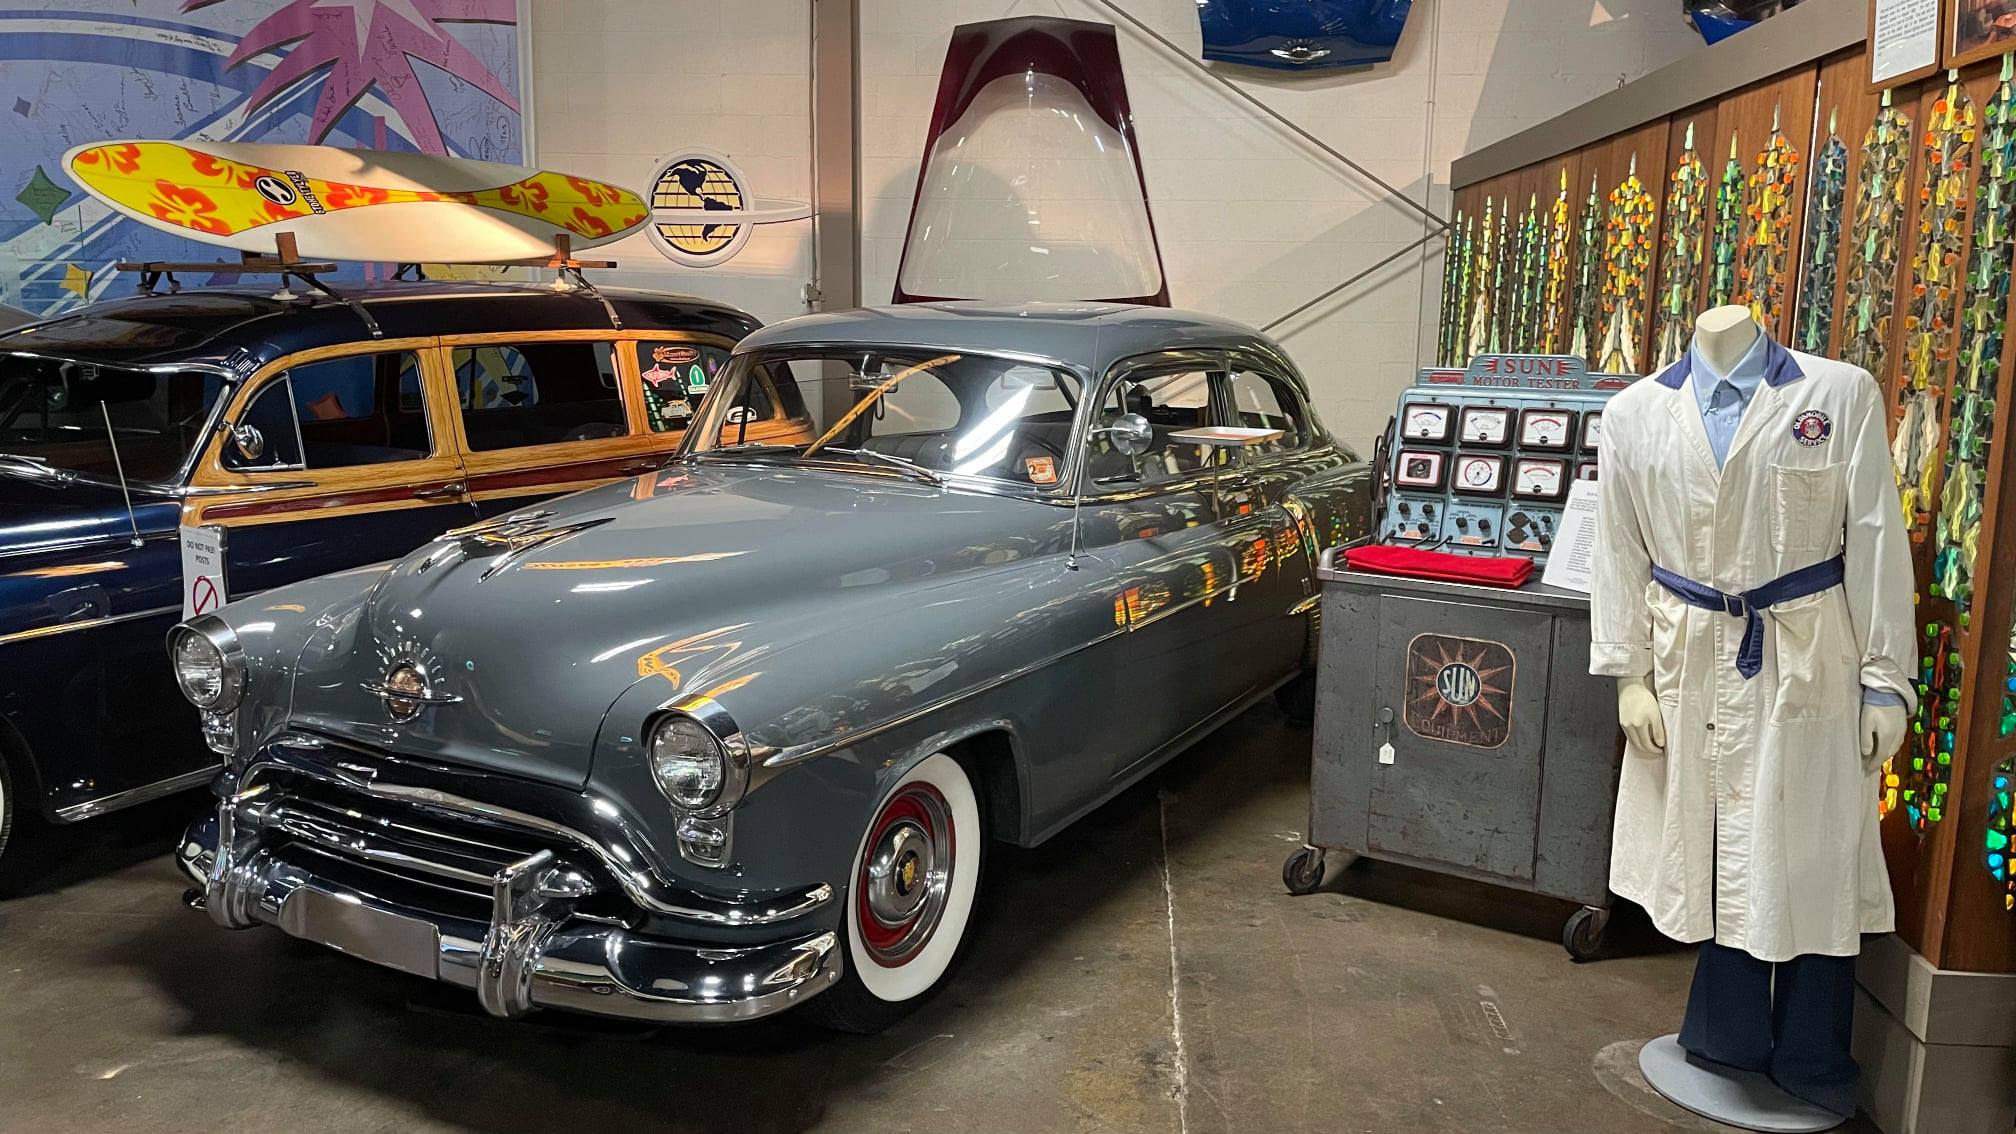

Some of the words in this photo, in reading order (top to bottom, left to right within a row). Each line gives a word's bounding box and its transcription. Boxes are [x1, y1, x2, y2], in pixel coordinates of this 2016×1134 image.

[1503, 358, 1554, 375] SUN
[694, 370, 700, 383] 1
[1473, 376, 1520, 388] MOTOR
[1527, 378, 1581, 390] TESTER
[1793, 411, 1831, 430] OLDSMOBILE
[1029, 464, 1037, 475] 2
[186, 540, 194, 549] DO
[194, 542, 204, 551] NOT
[195, 554, 210, 566] POSTS
[1442, 666, 1477, 702] SUN
[1412, 713, 1499, 743] QUIPMENT
